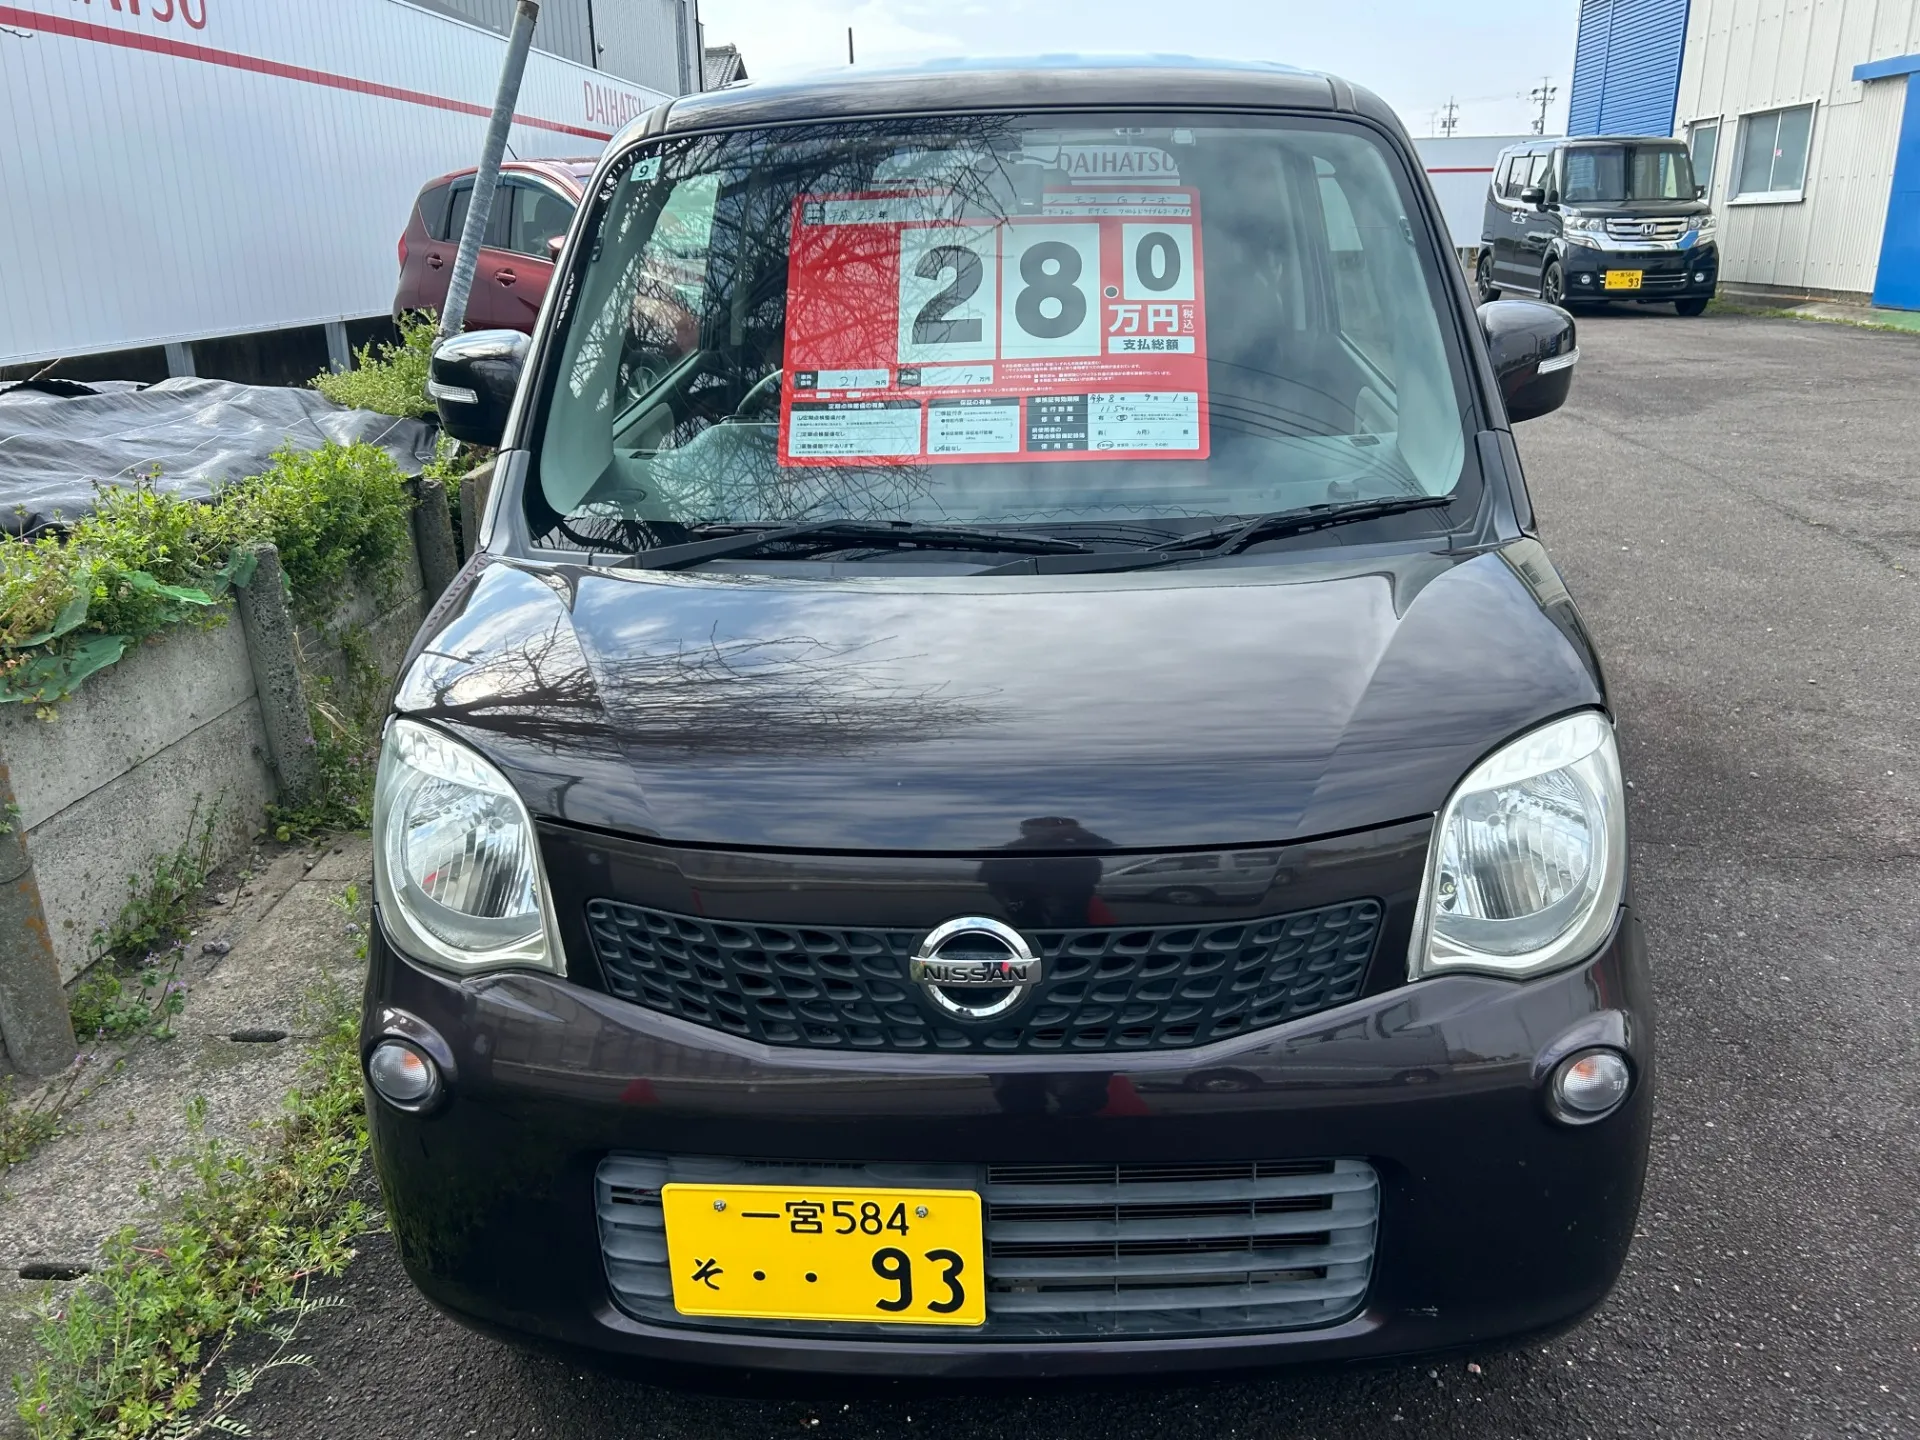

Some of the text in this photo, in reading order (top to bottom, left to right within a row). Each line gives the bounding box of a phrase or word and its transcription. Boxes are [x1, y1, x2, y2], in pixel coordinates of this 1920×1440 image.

[1108, 304, 1179, 333] 万円
[1123, 339, 1179, 351] 支払総額
[923, 965, 1028, 983] NISSAN
[871, 1246, 966, 1314] 93
